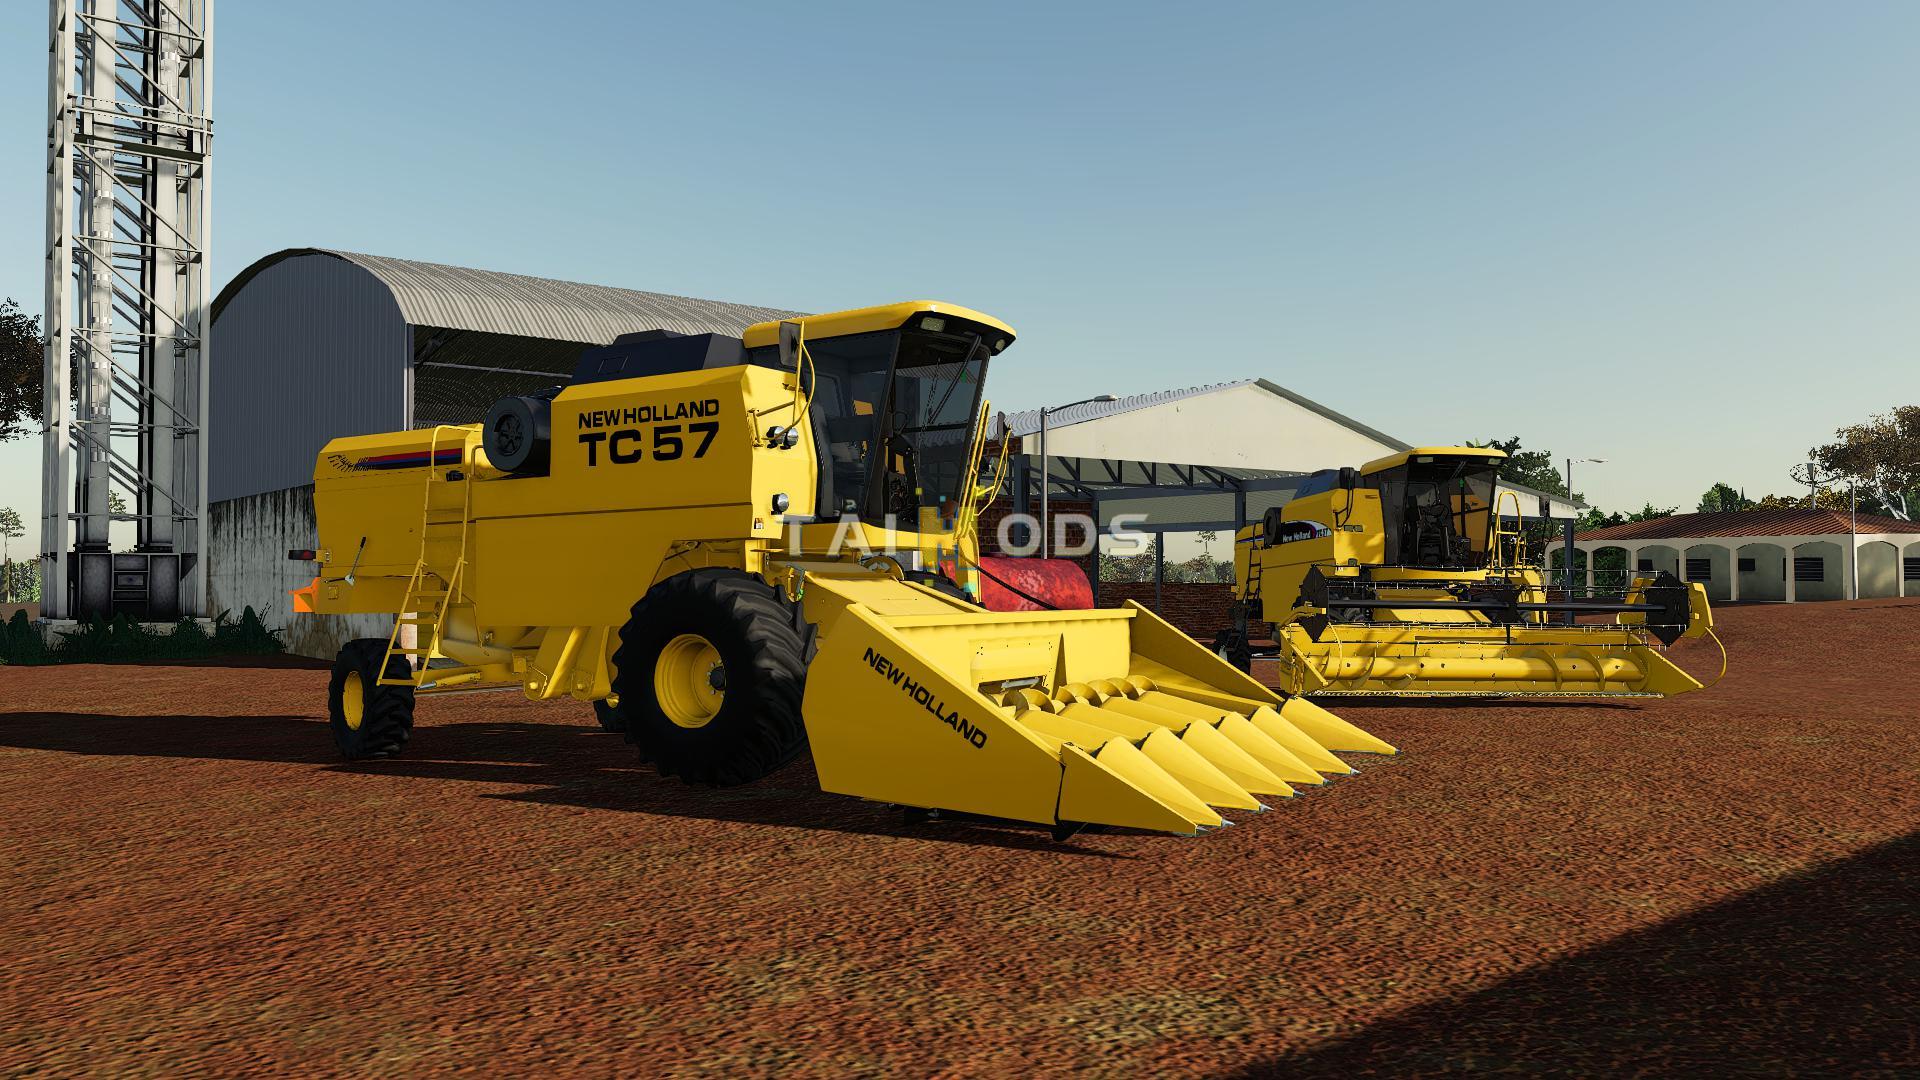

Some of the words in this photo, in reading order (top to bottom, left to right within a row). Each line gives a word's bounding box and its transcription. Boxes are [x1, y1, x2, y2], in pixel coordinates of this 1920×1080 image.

[578, 408, 621, 429] NEW
[623, 399, 720, 425] HOLLAND
[578, 428, 642, 467] TC
[652, 421, 720, 462] 57
[863, 647, 905, 685] NEW
[902, 676, 988, 749] HOLLAND
